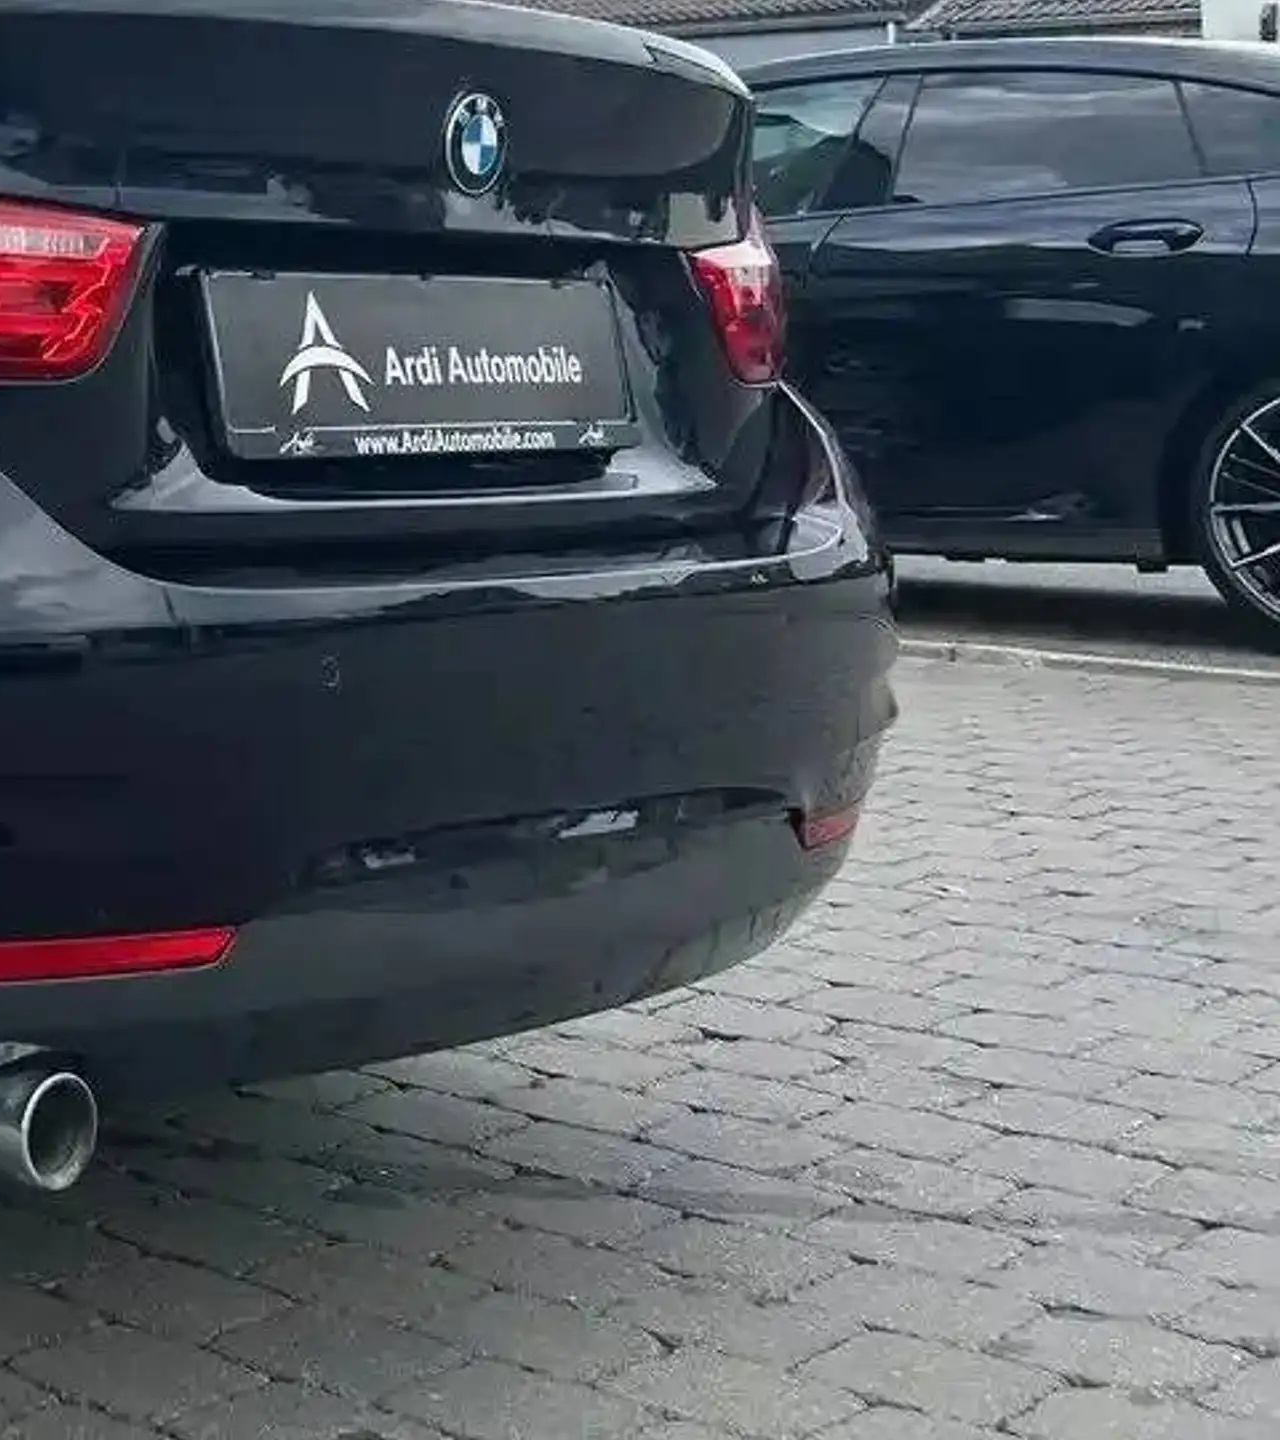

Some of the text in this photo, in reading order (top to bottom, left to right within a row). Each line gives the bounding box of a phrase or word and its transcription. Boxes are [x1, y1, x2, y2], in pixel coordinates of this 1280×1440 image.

[385, 346, 583, 386] Ardi Automobile
[354, 426, 557, 455] www.ArdiAutomobile.com
